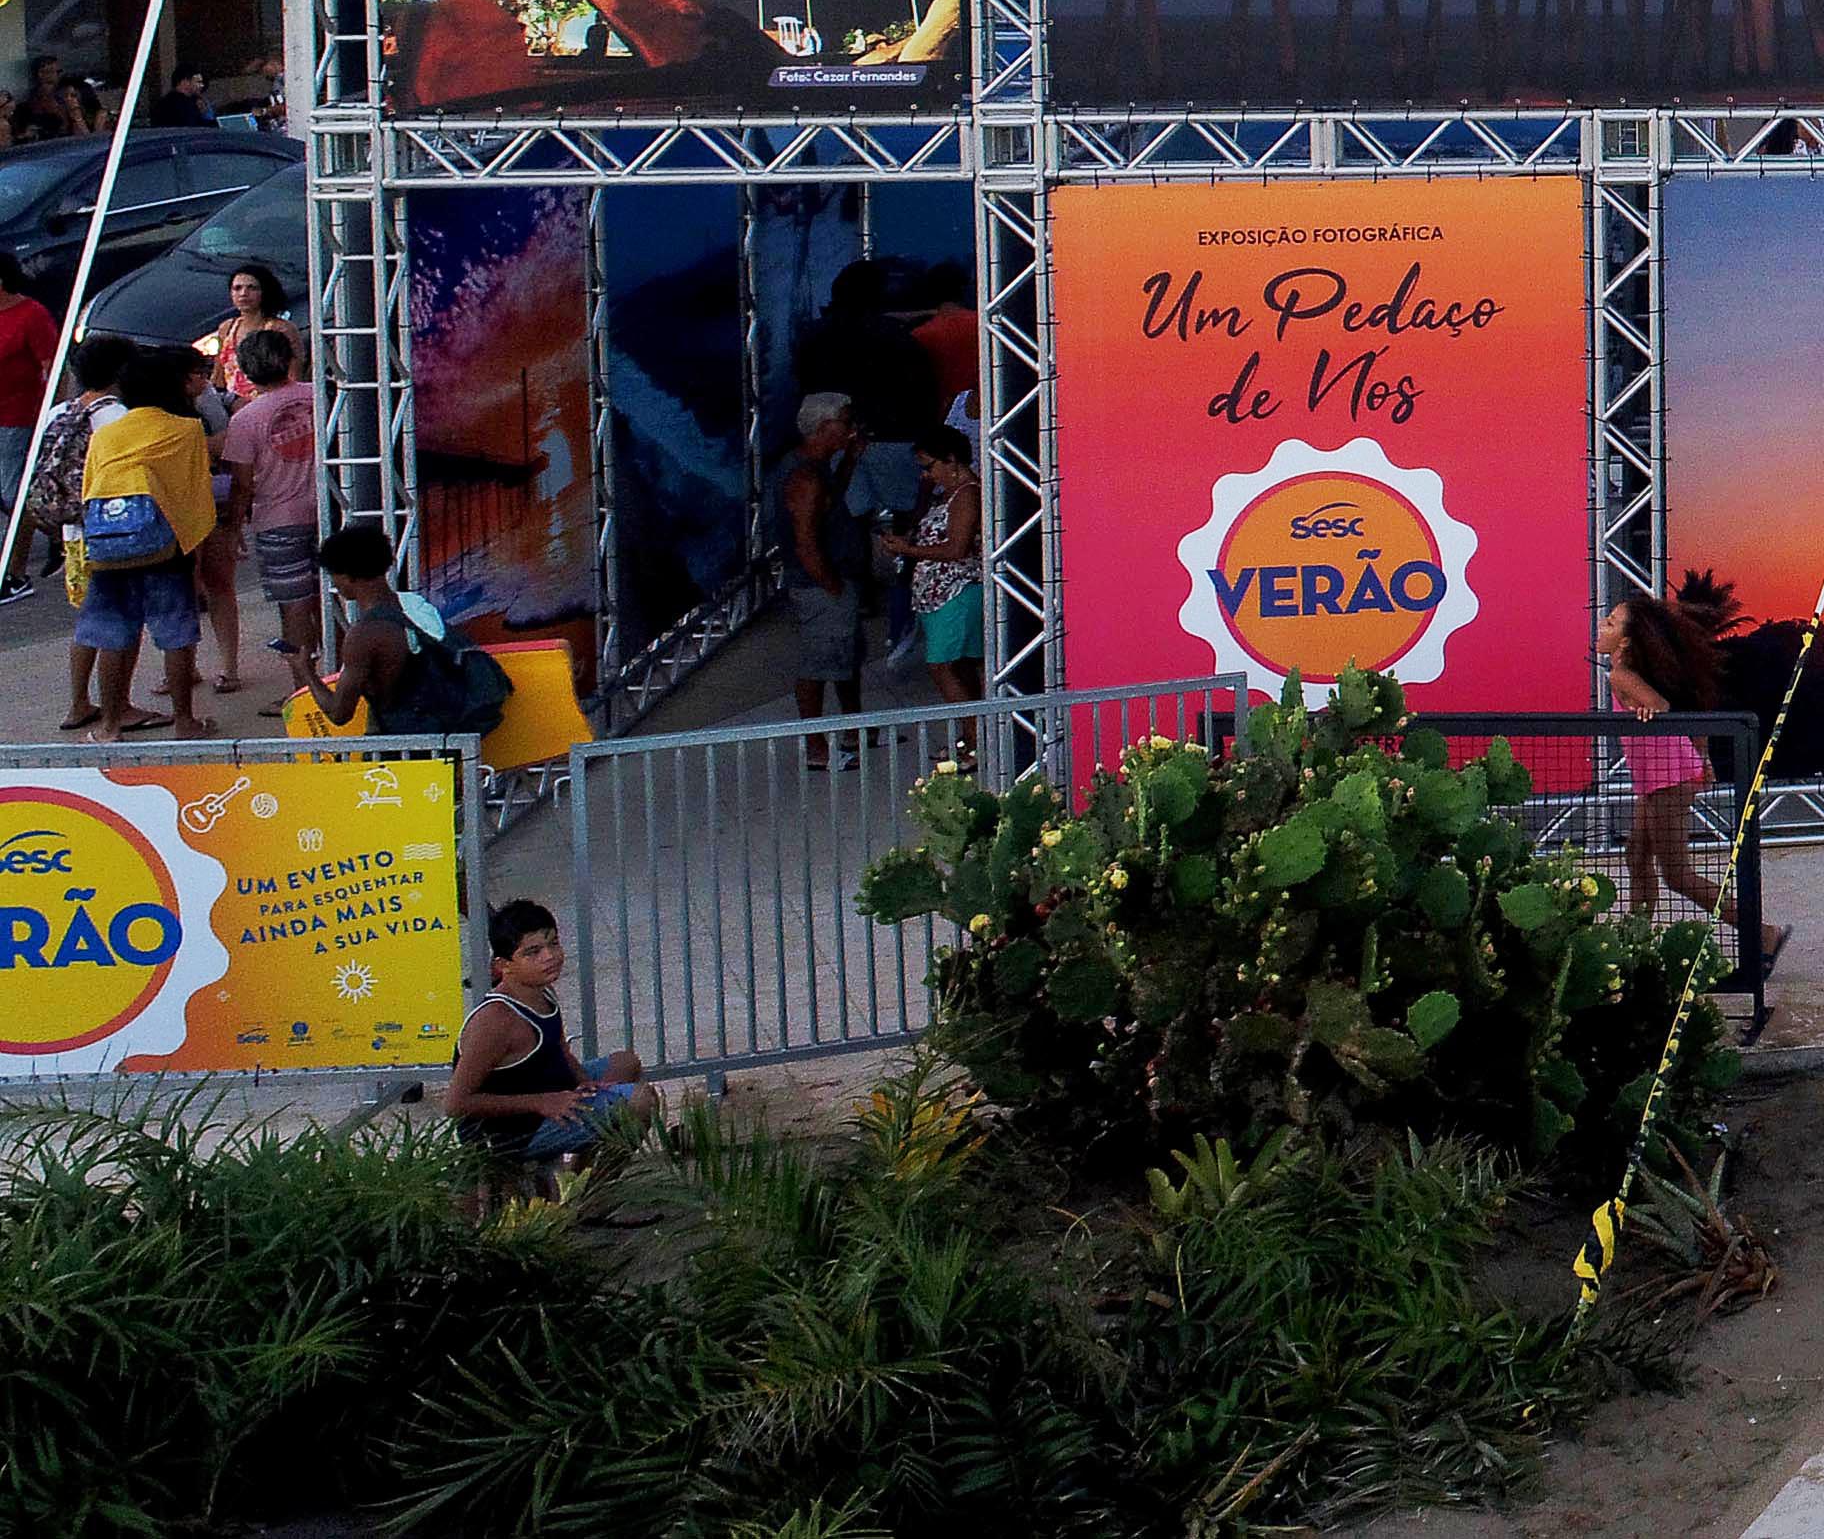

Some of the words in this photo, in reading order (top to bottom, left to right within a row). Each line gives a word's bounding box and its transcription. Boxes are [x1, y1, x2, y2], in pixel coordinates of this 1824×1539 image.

[779, 72, 811, 82] Foto:
[814, 71, 850, 82] Cezar
[852, 71, 916, 81] Fernandes
[1198, 227, 1307, 248] EXPOSIÇÃO
[1313, 223, 1444, 245] FOTOGRÁFICA
[1142, 270, 1253, 342] Um
[1263, 262, 1505, 342] Pedaço
[1208, 351, 1282, 424] de
[1307, 345, 1424, 425] Nós
[1205, 549, 1448, 619] VERÃO
[0, 849, 72, 875] esc
[237, 877, 278, 895] UM
[287, 851, 394, 889] EVENTO
[260, 899, 307, 916] PARA
[313, 871, 424, 906] ESQUENTAR
[240, 914, 328, 944] AINDA
[336, 895, 403, 924] MAIS
[314, 941, 328, 954] A
[335, 928, 379, 949] SUA
[386, 917, 453, 936] VIDA.
